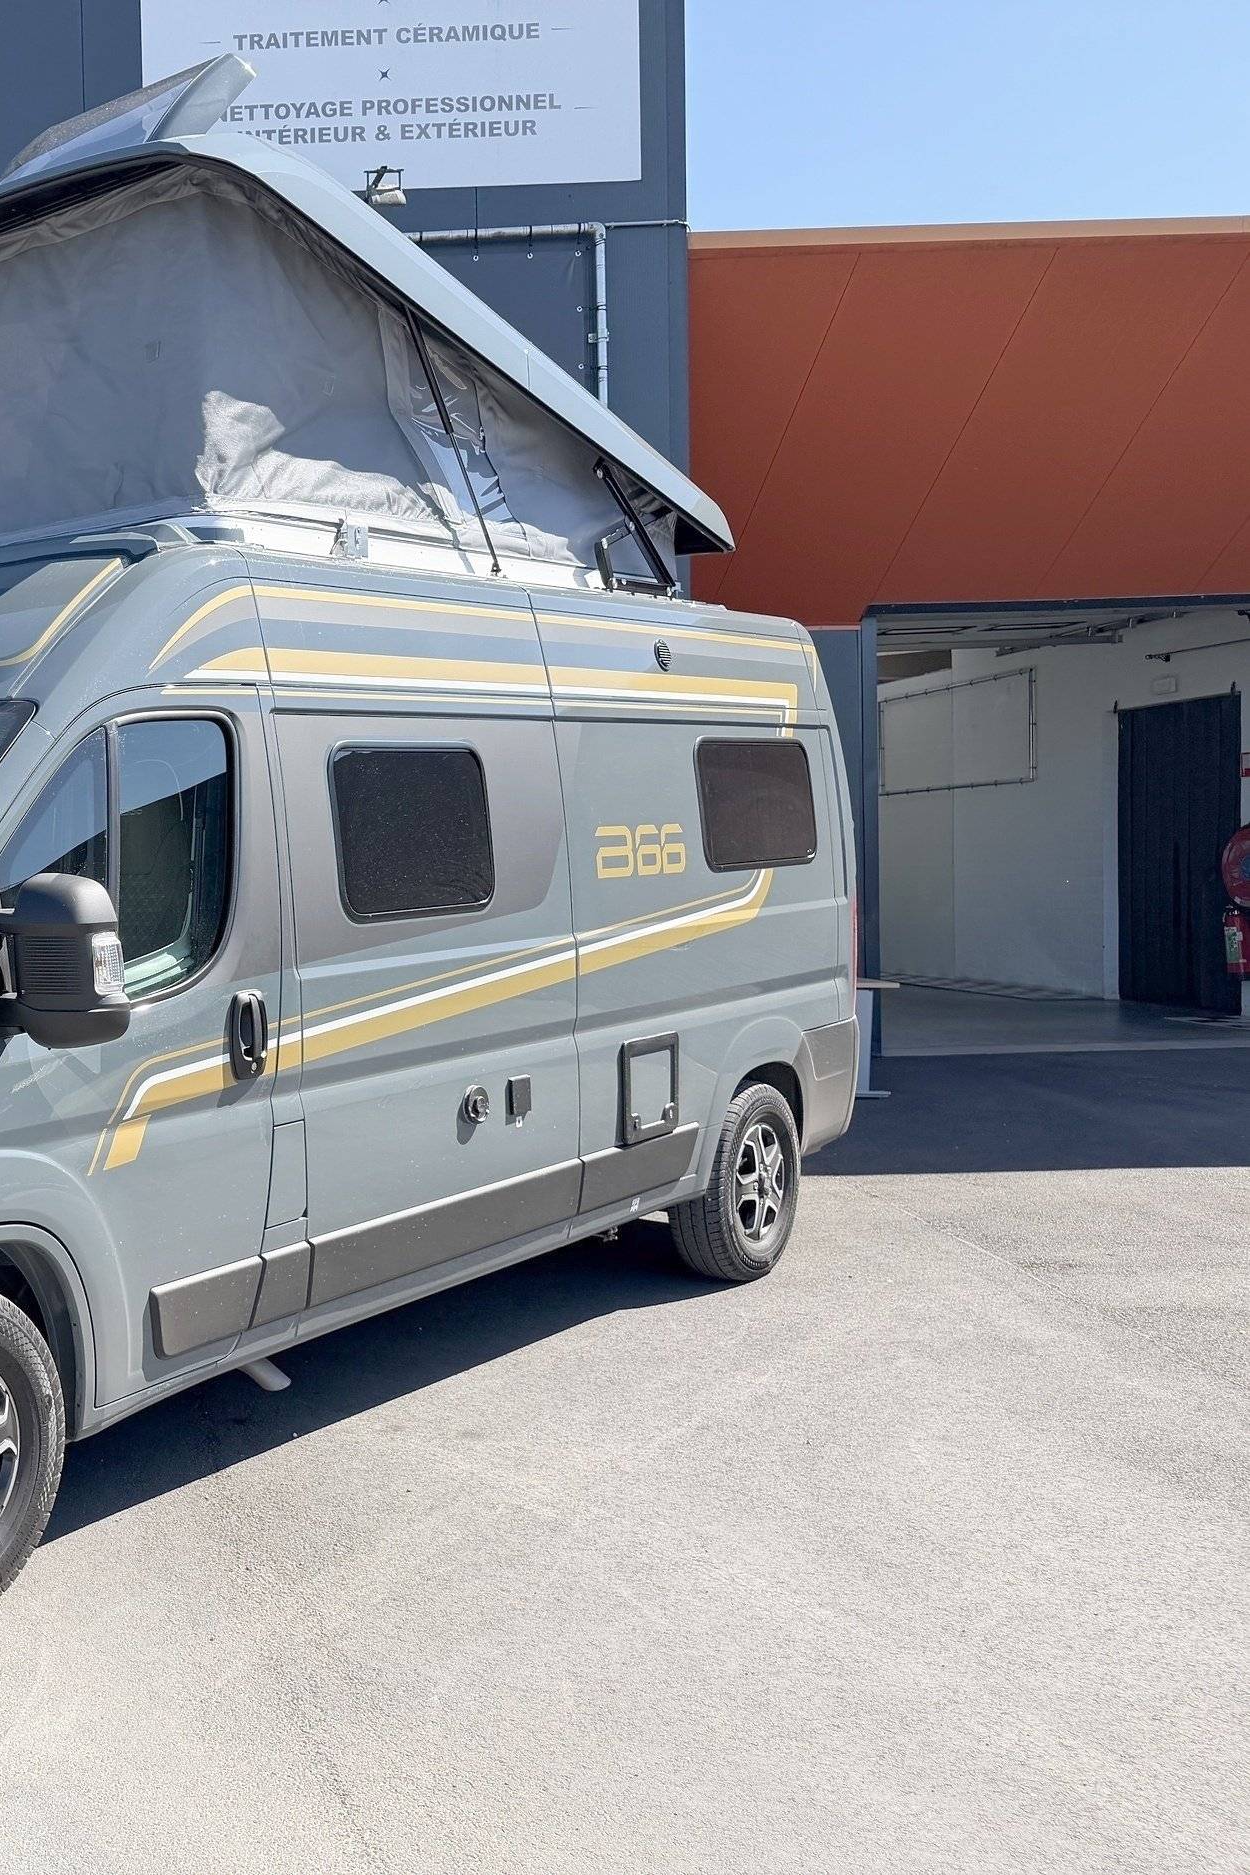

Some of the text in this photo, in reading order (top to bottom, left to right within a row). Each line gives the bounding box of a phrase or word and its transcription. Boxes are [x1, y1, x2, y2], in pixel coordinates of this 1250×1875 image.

[232, 22, 540, 51] TRAITEMENT CÉRAMIQUE
[361, 93, 562, 117] PROFESSIONNEL
[237, 118, 538, 146] TÉRIEUR & EXTÉRIEUR
